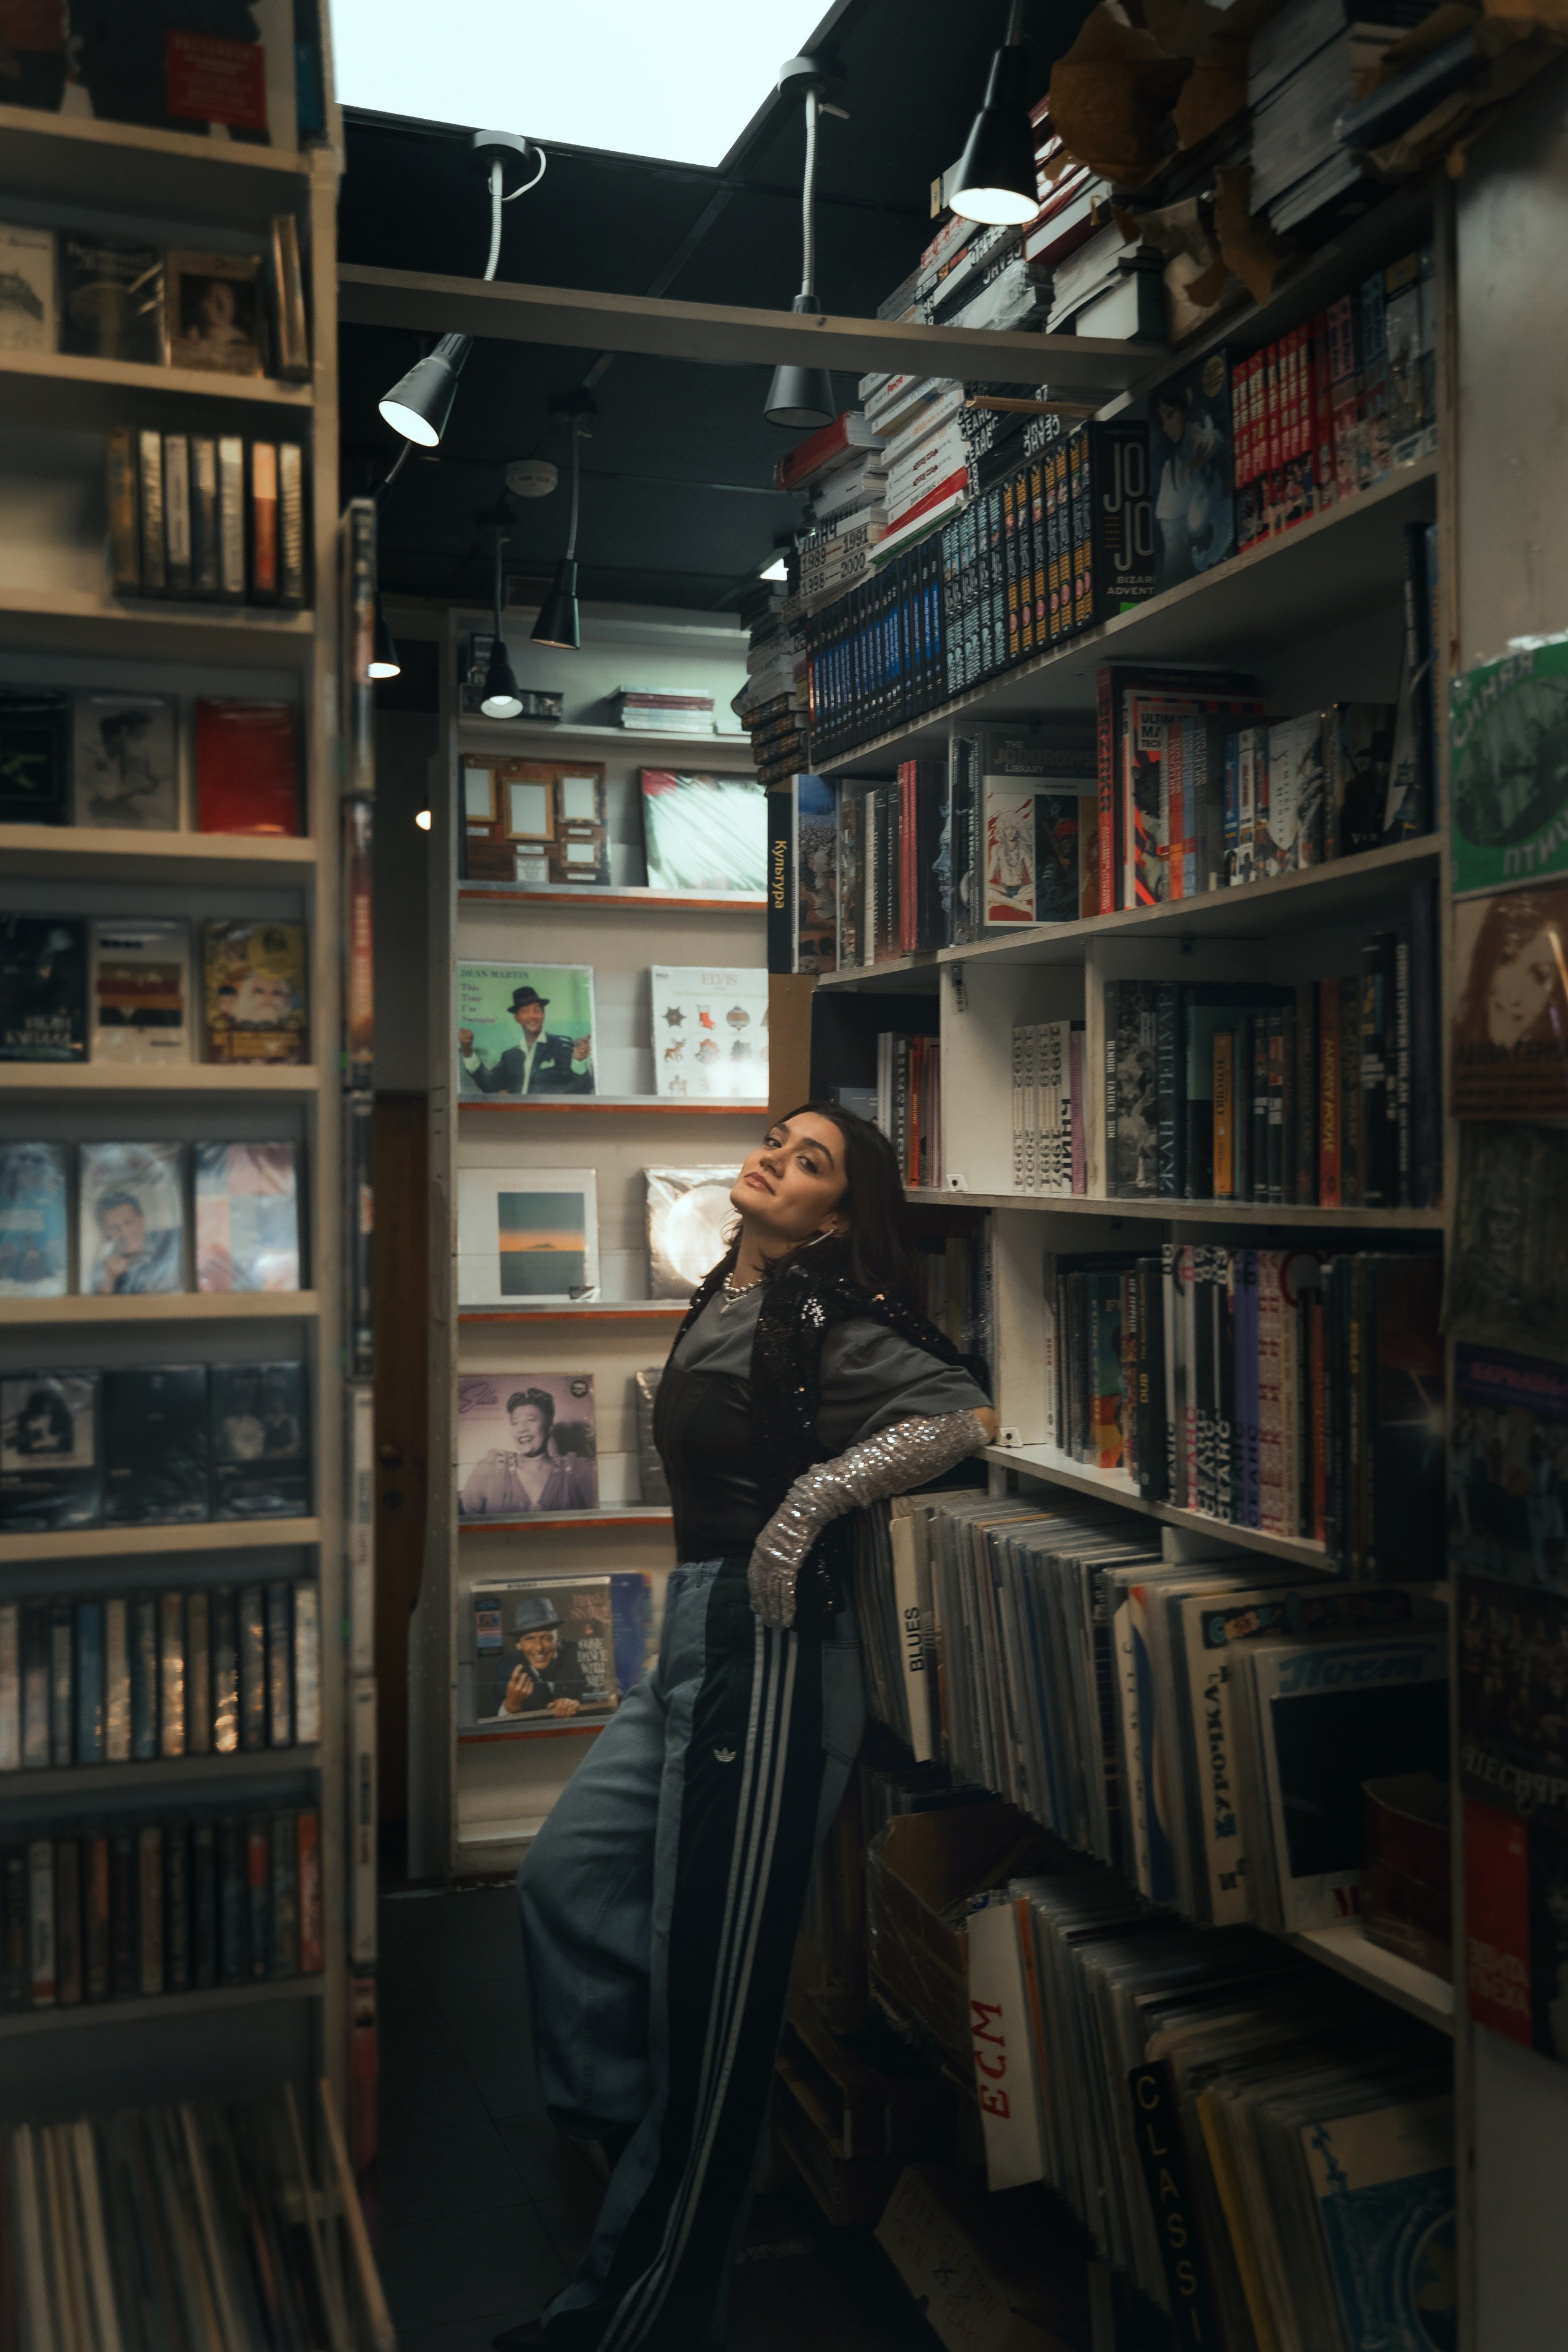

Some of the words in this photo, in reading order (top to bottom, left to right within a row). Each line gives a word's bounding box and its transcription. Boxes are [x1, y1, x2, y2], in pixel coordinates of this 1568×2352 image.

[1103, 442, 1145, 513] JO
[1114, 501, 1154, 571] JO
[1107, 586, 1155, 596] ADVENT
[1117, 575, 1155, 584] BIZAR
[993, 747, 1096, 767] JODOROWS
[773, 840, 788, 910] Культура
[1502, 809, 1568, 876] ПТИЦ
[904, 1606, 924, 1673] BLUES
[970, 1998, 1011, 2121] ECM
[1134, 2075, 1202, 2342] CLASSI
